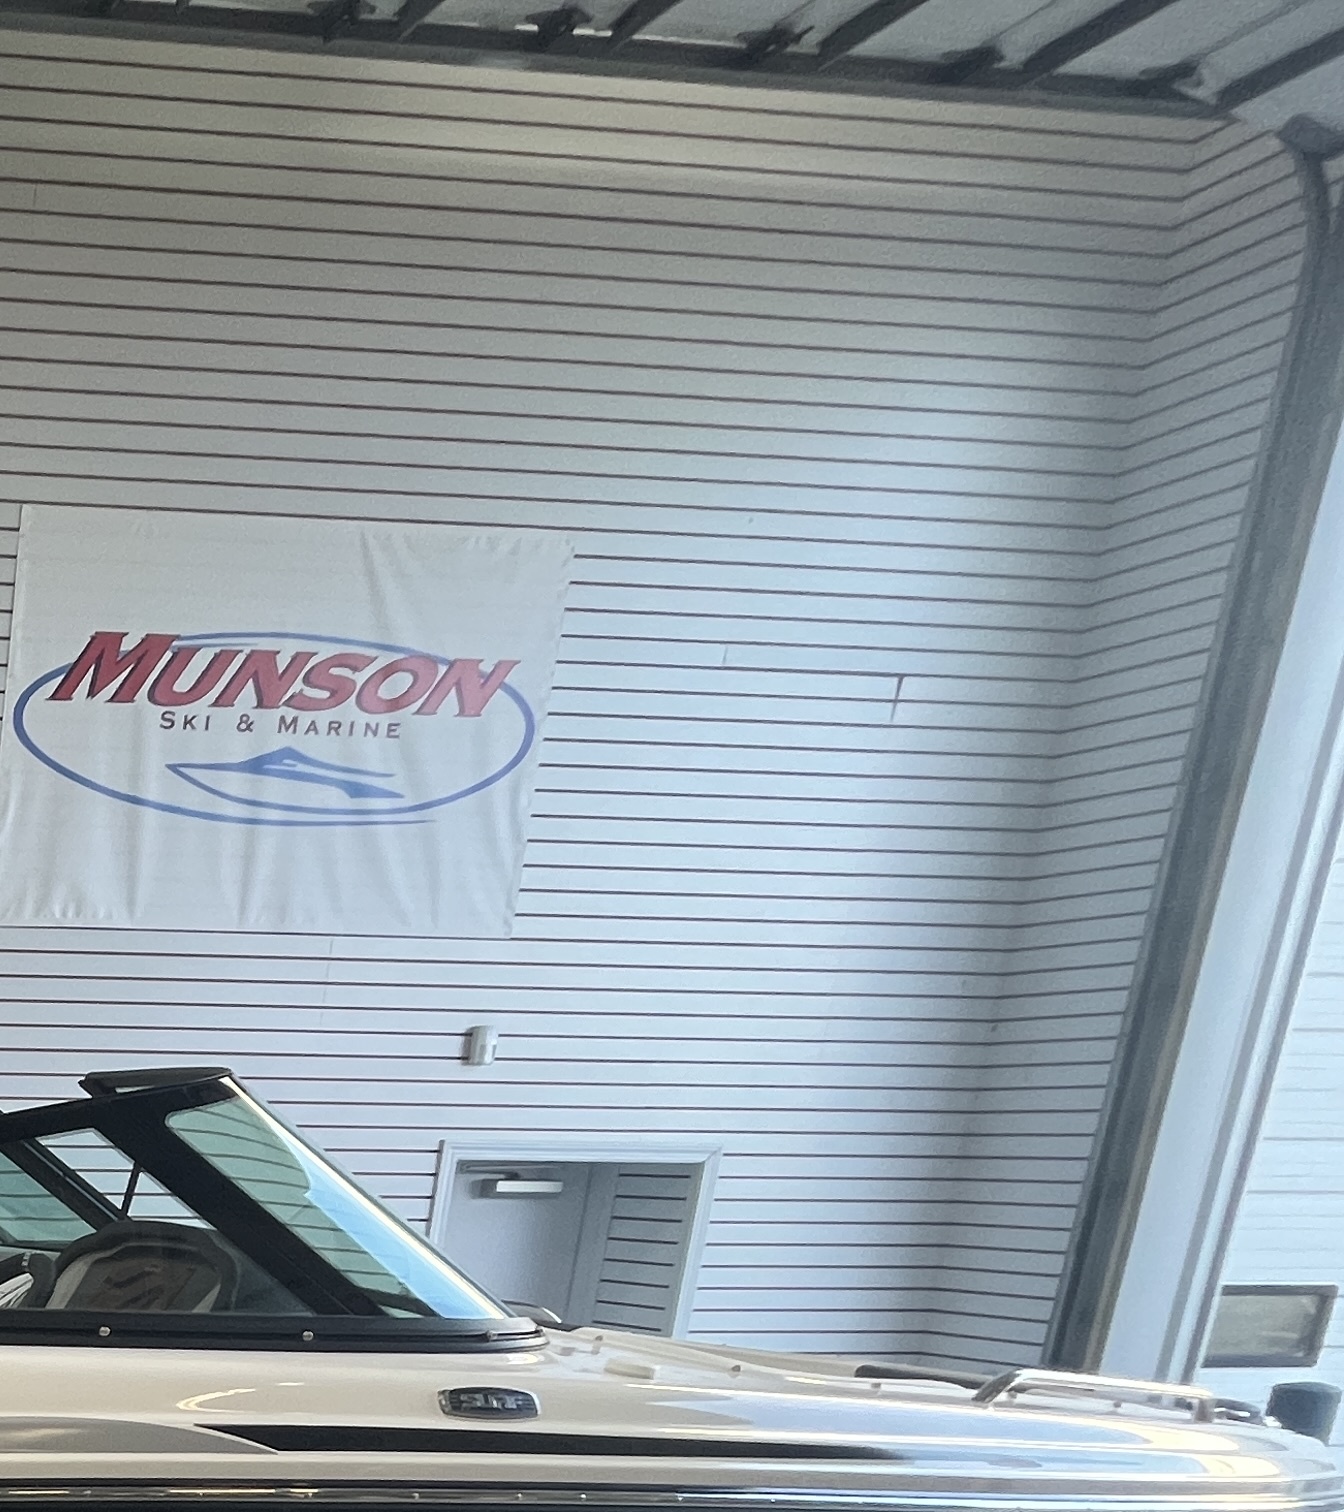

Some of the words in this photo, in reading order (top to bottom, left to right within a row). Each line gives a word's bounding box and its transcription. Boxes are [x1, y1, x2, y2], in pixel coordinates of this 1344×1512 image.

[45, 630, 521, 718] MUNSON
[159, 710, 211, 731] SKI
[236, 713, 254, 732] &
[276, 715, 402, 739] MARINE
